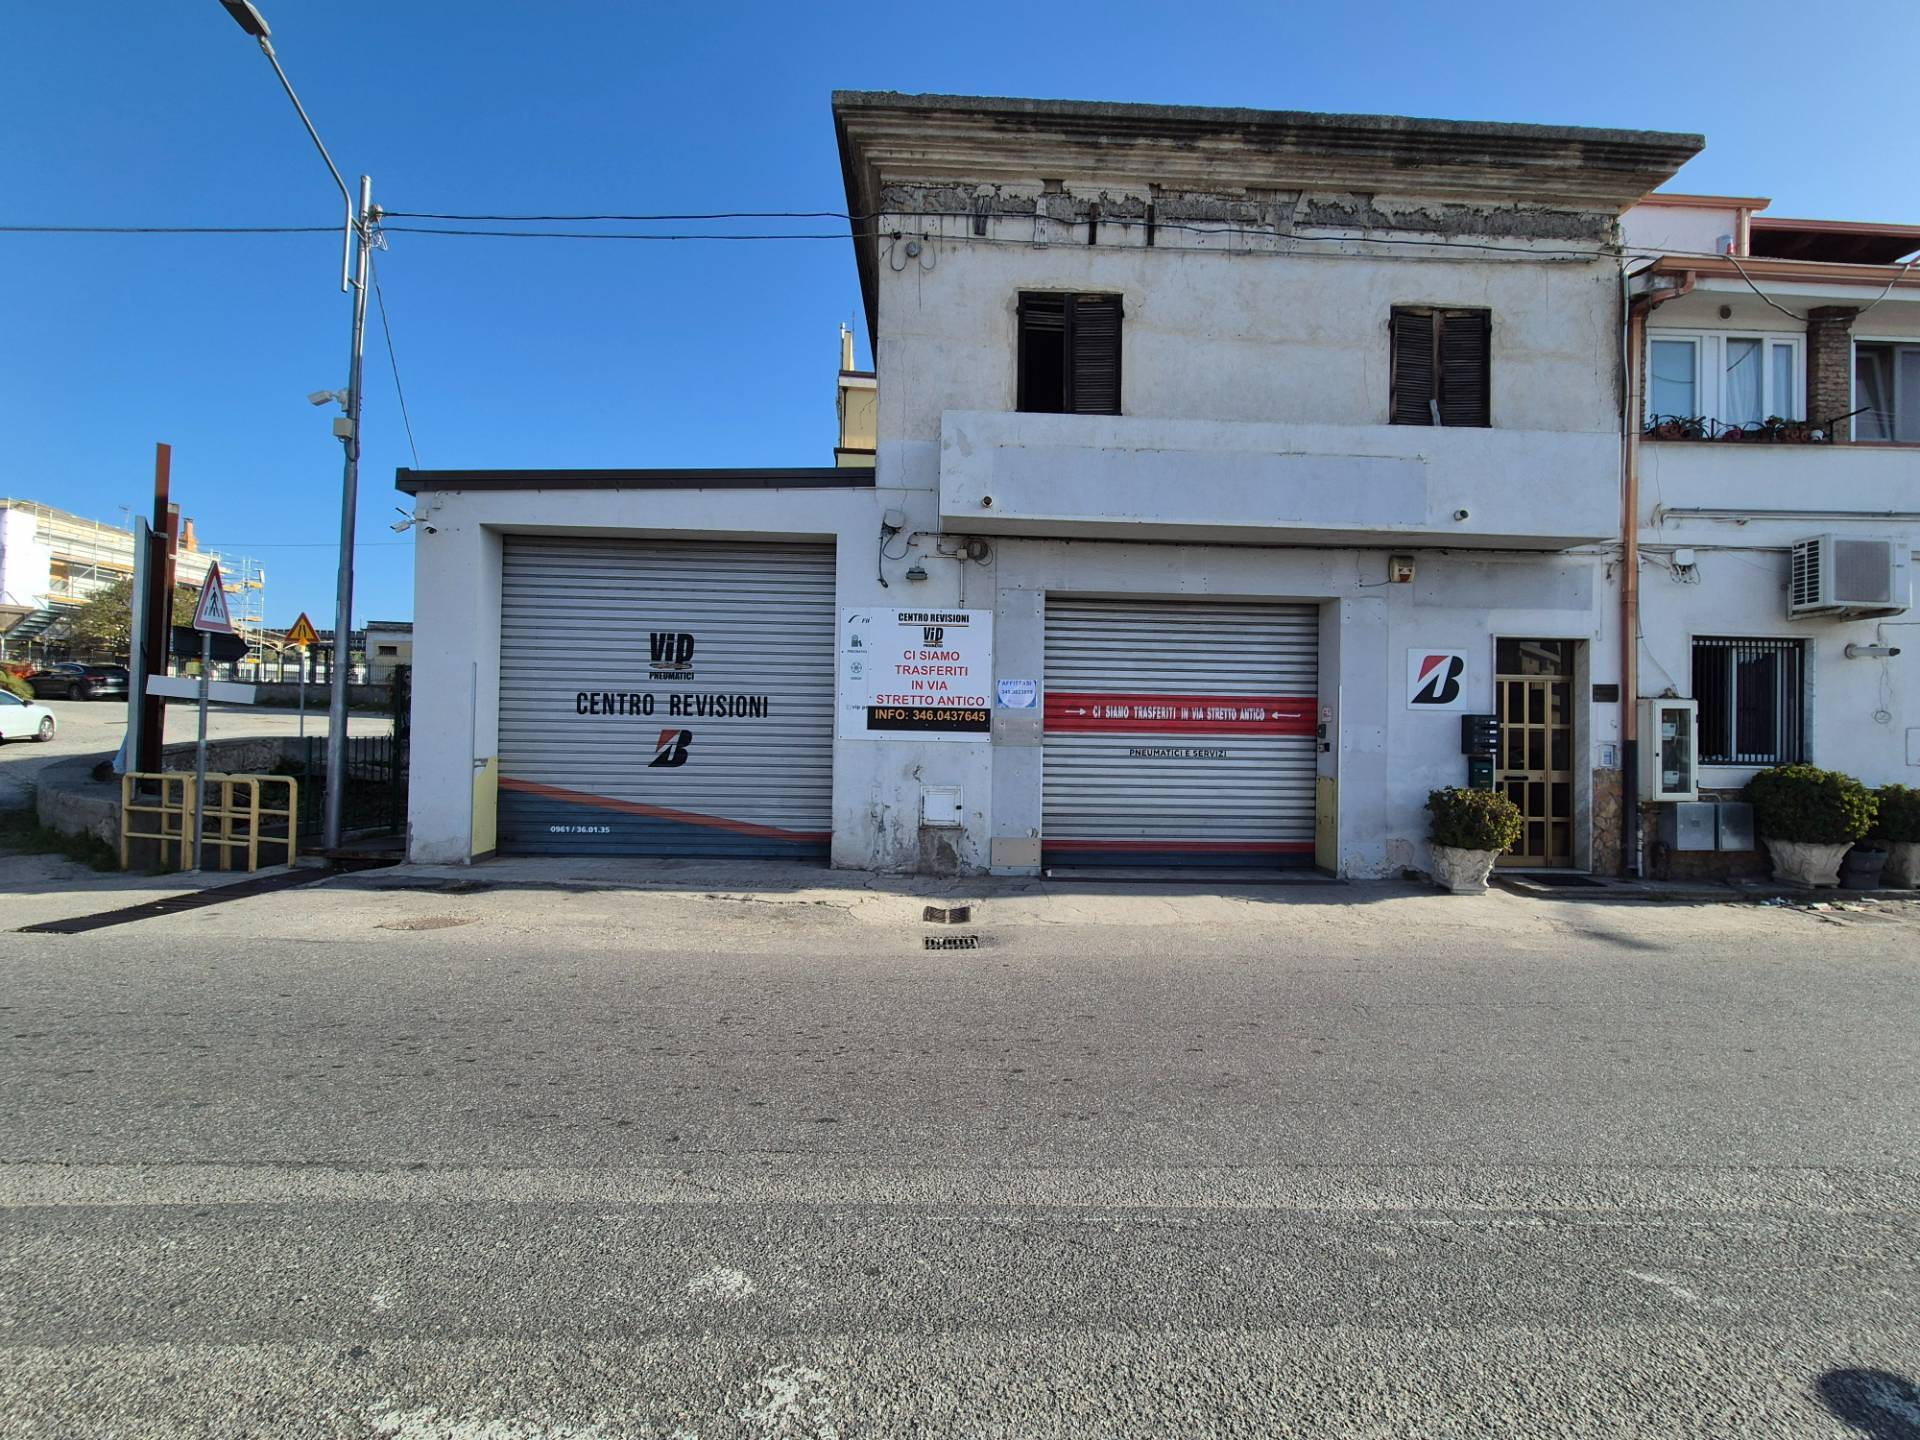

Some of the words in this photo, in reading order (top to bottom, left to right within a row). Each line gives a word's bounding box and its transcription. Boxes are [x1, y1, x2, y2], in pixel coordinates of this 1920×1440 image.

[898, 613, 928, 622] CENTRO
[930, 614, 969, 623] REVISIONI
[903, 650, 916, 661] CI
[919, 651, 960, 662] SIAMO
[649, 671, 694, 681] PNEUMATICI
[894, 664, 968, 677] TRASFERITI
[911, 680, 924, 691] IN
[927, 681, 948, 691] VIA
[576, 692, 654, 716] CENTRO
[669, 694, 768, 718] REVISIONI
[876, 694, 934, 706] STRETTO
[937, 695, 985, 707] ANTICO
[875, 709, 909, 720] INFO:
[913, 710, 986, 722] 346.0437645
[1092, 705, 1101, 719] CI
[1105, 705, 1129, 719] SIAMO
[1134, 706, 1176, 720] TRASFERITI
[1181, 707, 1188, 720] IN
[1192, 707, 1204, 720] VIA
[1207, 707, 1237, 720] STRETTO
[1129, 749, 1183, 757] PNEUMATICI
[1185, 749, 1190, 757] E
[1193, 750, 1227, 758] SERVIZI
[550, 825, 569, 833] 0961
[576, 825, 610, 834] 36.01.35
